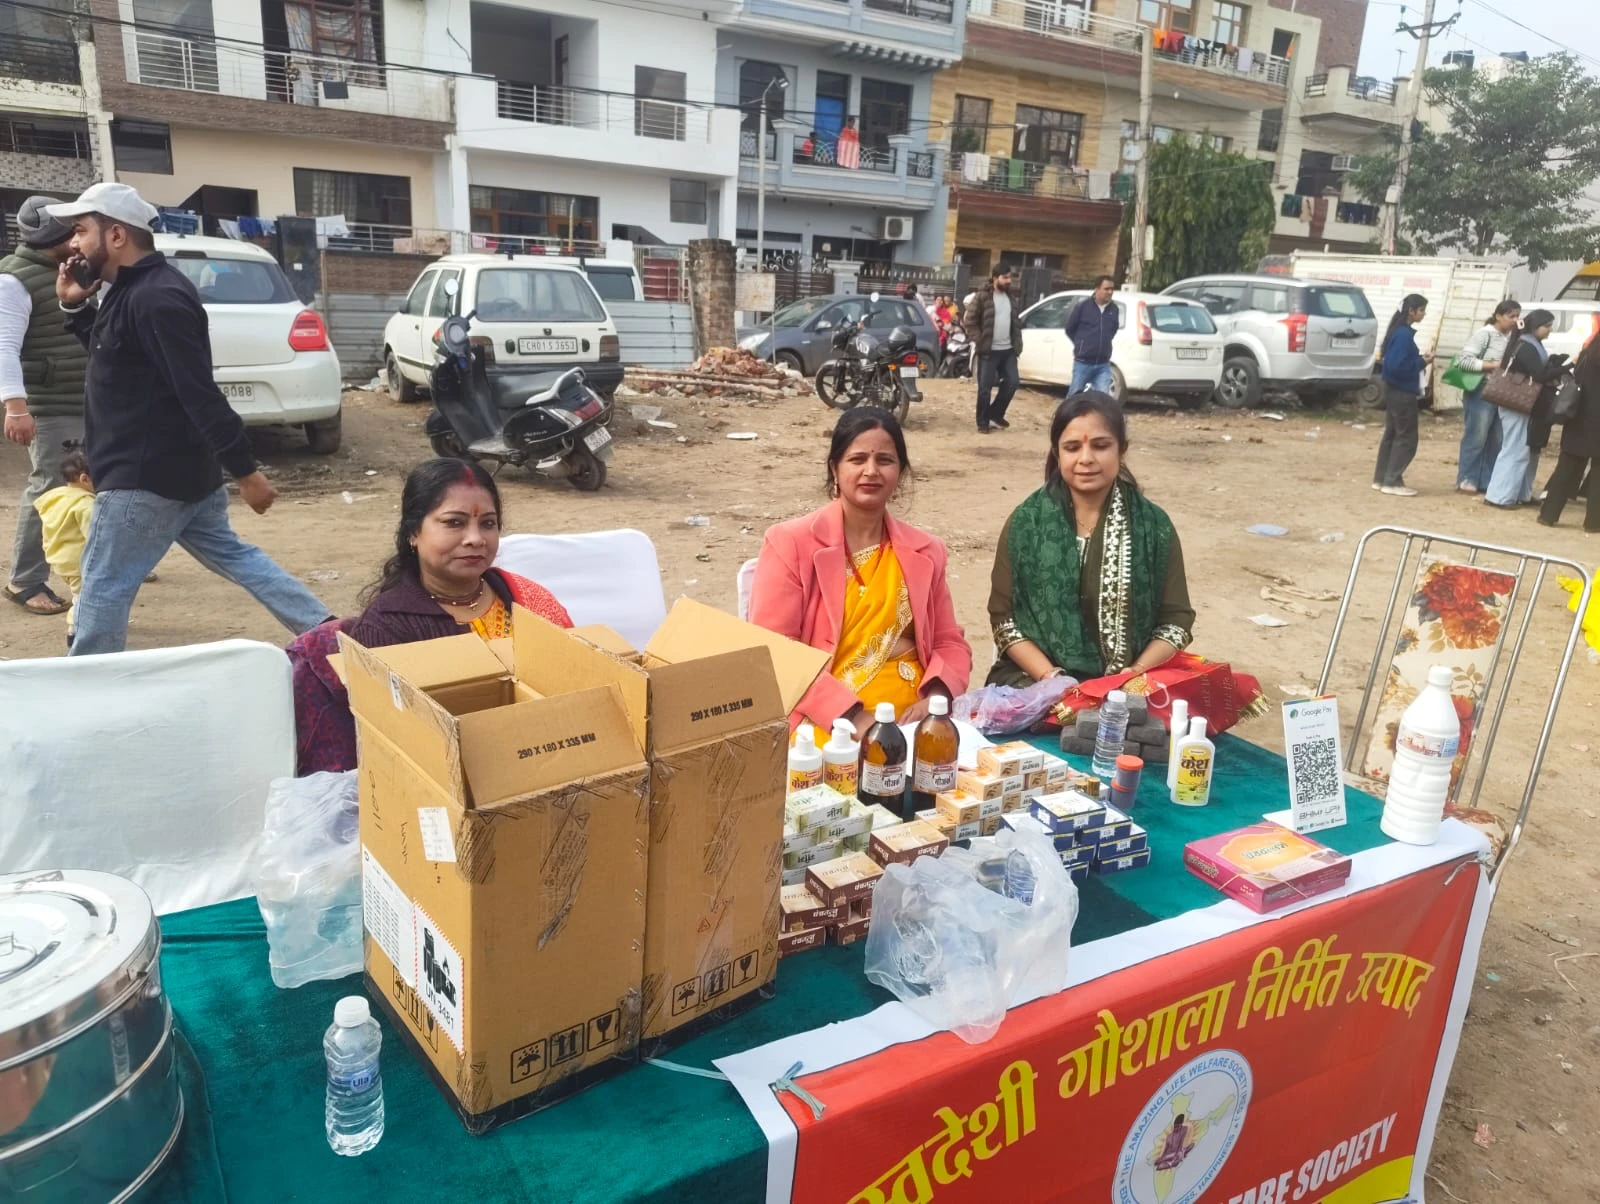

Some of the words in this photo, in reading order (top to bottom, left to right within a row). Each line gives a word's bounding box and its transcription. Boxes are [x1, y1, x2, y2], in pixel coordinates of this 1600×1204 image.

[691, 710, 703, 722] 290
[704, 708, 711, 718] X
[711, 706, 722, 716] 180
[723, 703, 729, 713] X
[729, 701, 741, 712] 335
[741, 698, 753, 709] MM
[518, 748, 533, 759] 290
[534, 746, 542, 755] X
[542, 743, 557, 753] 180
[557, 740, 566, 750] X
[566, 737, 581, 748] 335
[581, 733, 596, 744] MM
[1181, 756, 1210, 769] केश
[425, 983, 438, 1009] UN
[437, 1002, 455, 1031] 3481
[1057, 980, 1236, 1099] गौशाला
[1237, 934, 1352, 1030] निर्मित
[1346, 951, 1437, 1019] उत्पाद
[1121, 1154, 1133, 1176] THE
[1129, 1096, 1166, 1151] AMAZING
[1165, 1075, 1187, 1097] LIFE
[1189, 1057, 1229, 1078] WELFARE
[1227, 1057, 1249, 1089] SOCIETY
[1200, 1134, 1236, 1191] HAPPINESS
[1293, 1112, 1398, 1201] SOCIETY
